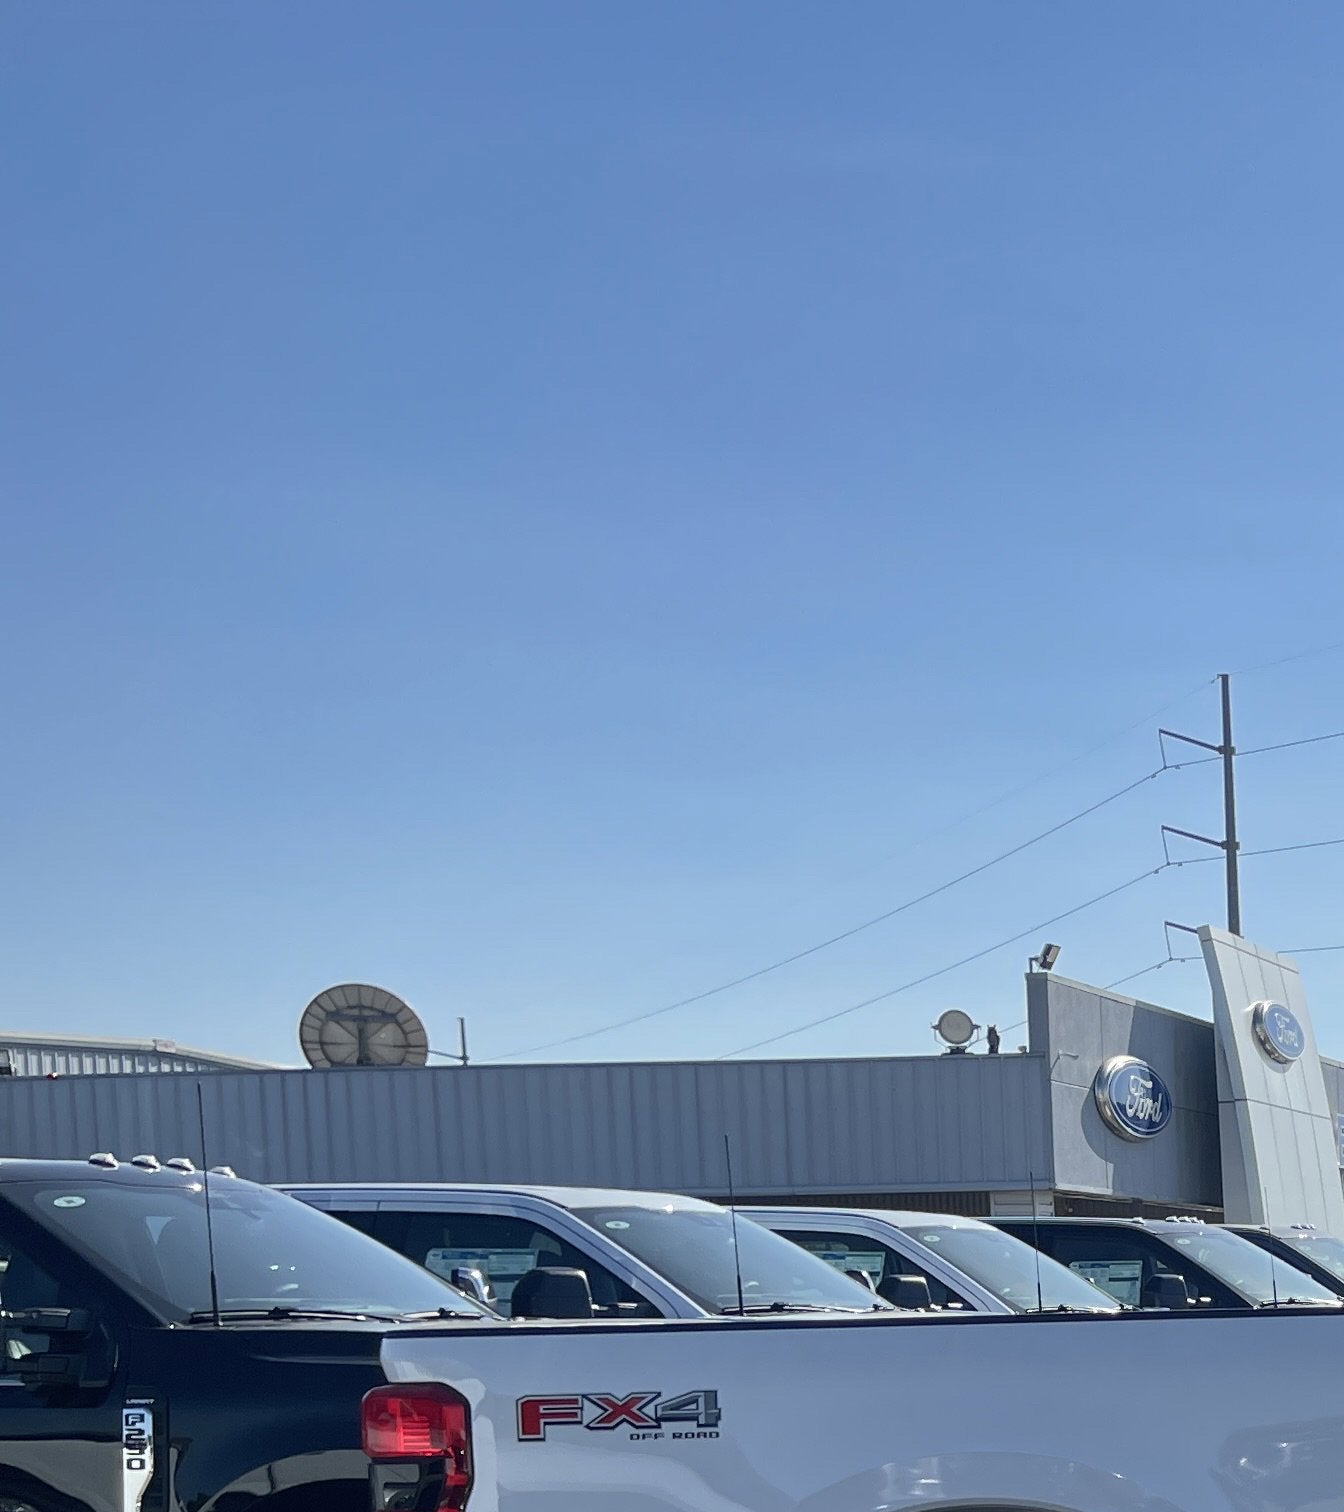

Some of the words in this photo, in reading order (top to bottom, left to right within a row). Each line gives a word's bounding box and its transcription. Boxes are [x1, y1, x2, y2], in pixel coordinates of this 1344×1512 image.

[1274, 1012, 1299, 1048] Ford
[1125, 1075, 1163, 1123] Ford
[515, 1389, 722, 1442] FX4
[629, 1432, 665, 1441] OFF
[672, 1431, 720, 1440] ROAD
